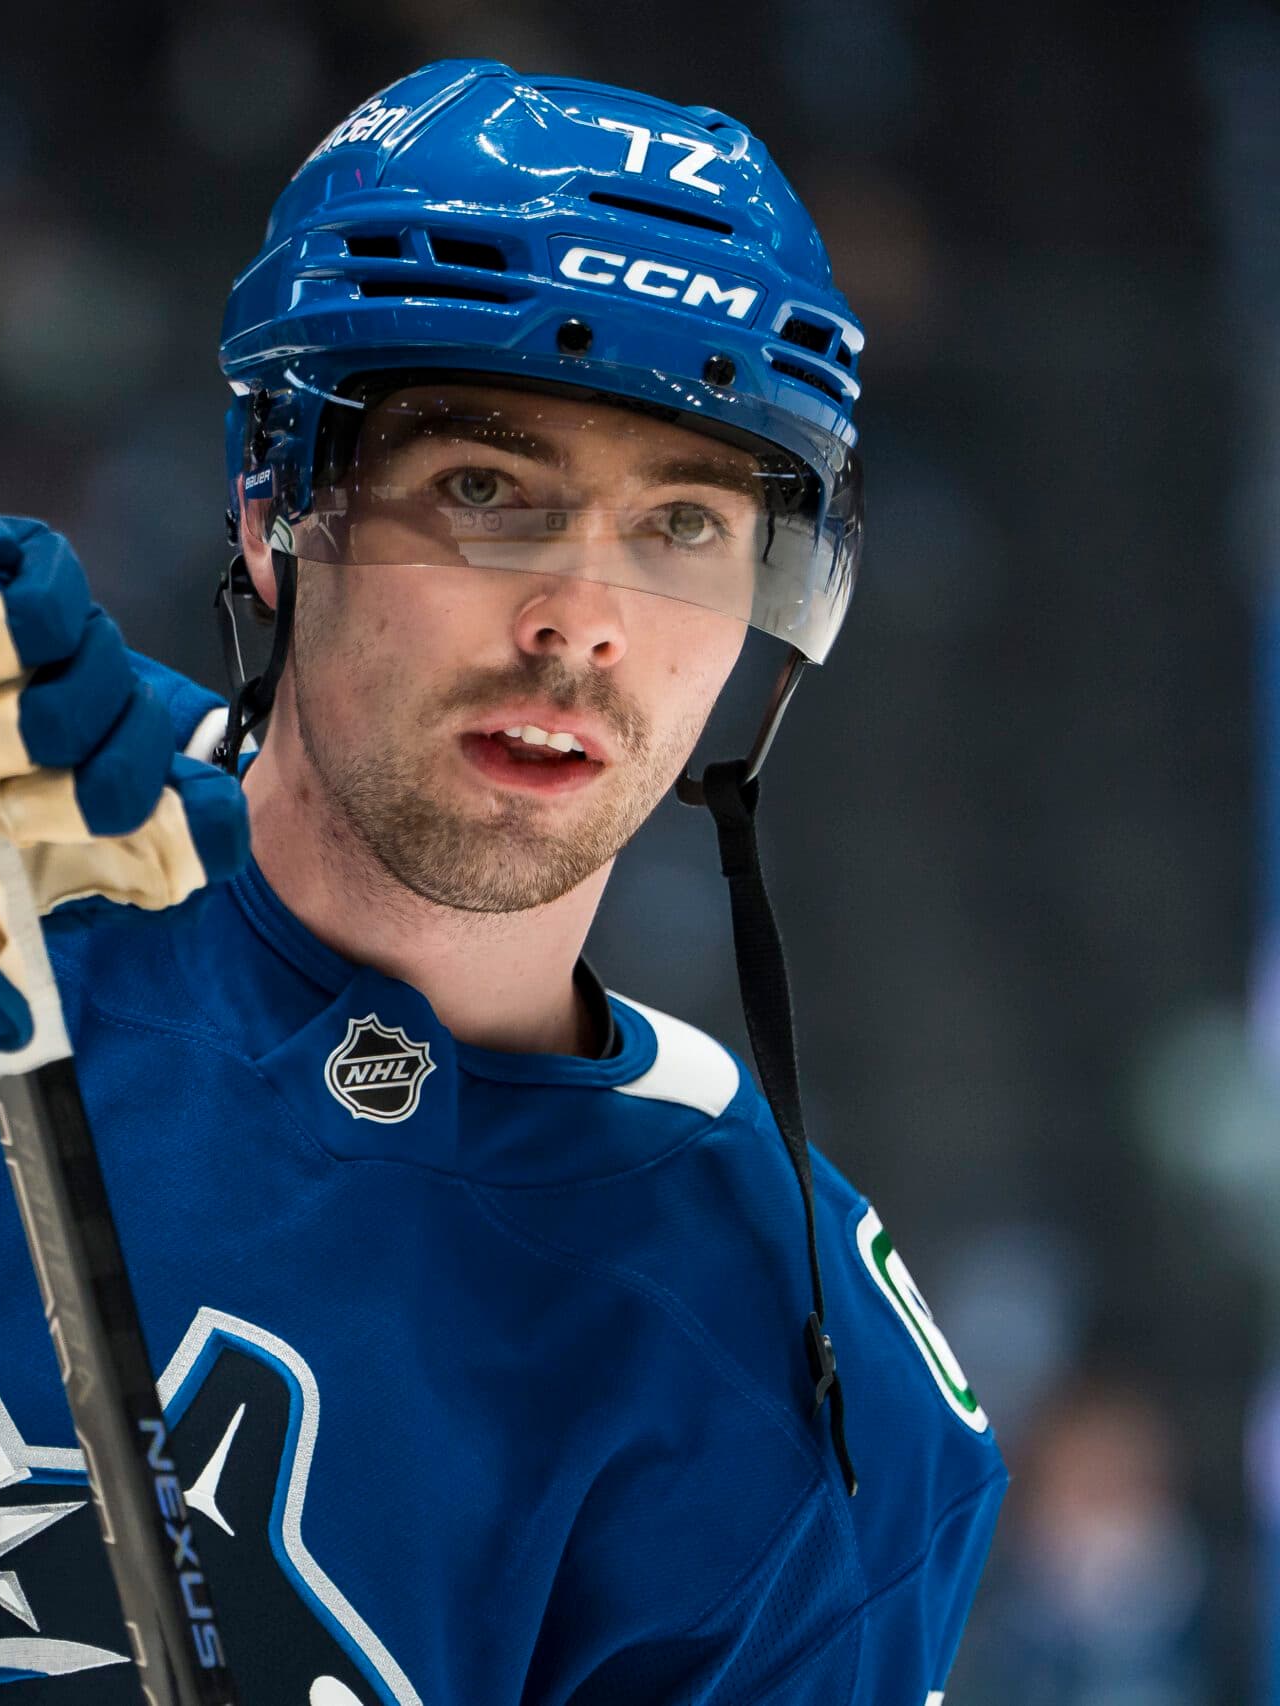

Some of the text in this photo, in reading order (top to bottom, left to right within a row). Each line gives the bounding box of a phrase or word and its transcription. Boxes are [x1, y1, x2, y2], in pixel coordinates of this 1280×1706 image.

[597, 117, 721, 196] 72
[559, 247, 759, 320] CCM
[343, 1060, 410, 1085] NHL
[137, 1419, 227, 1669] NEXUS
